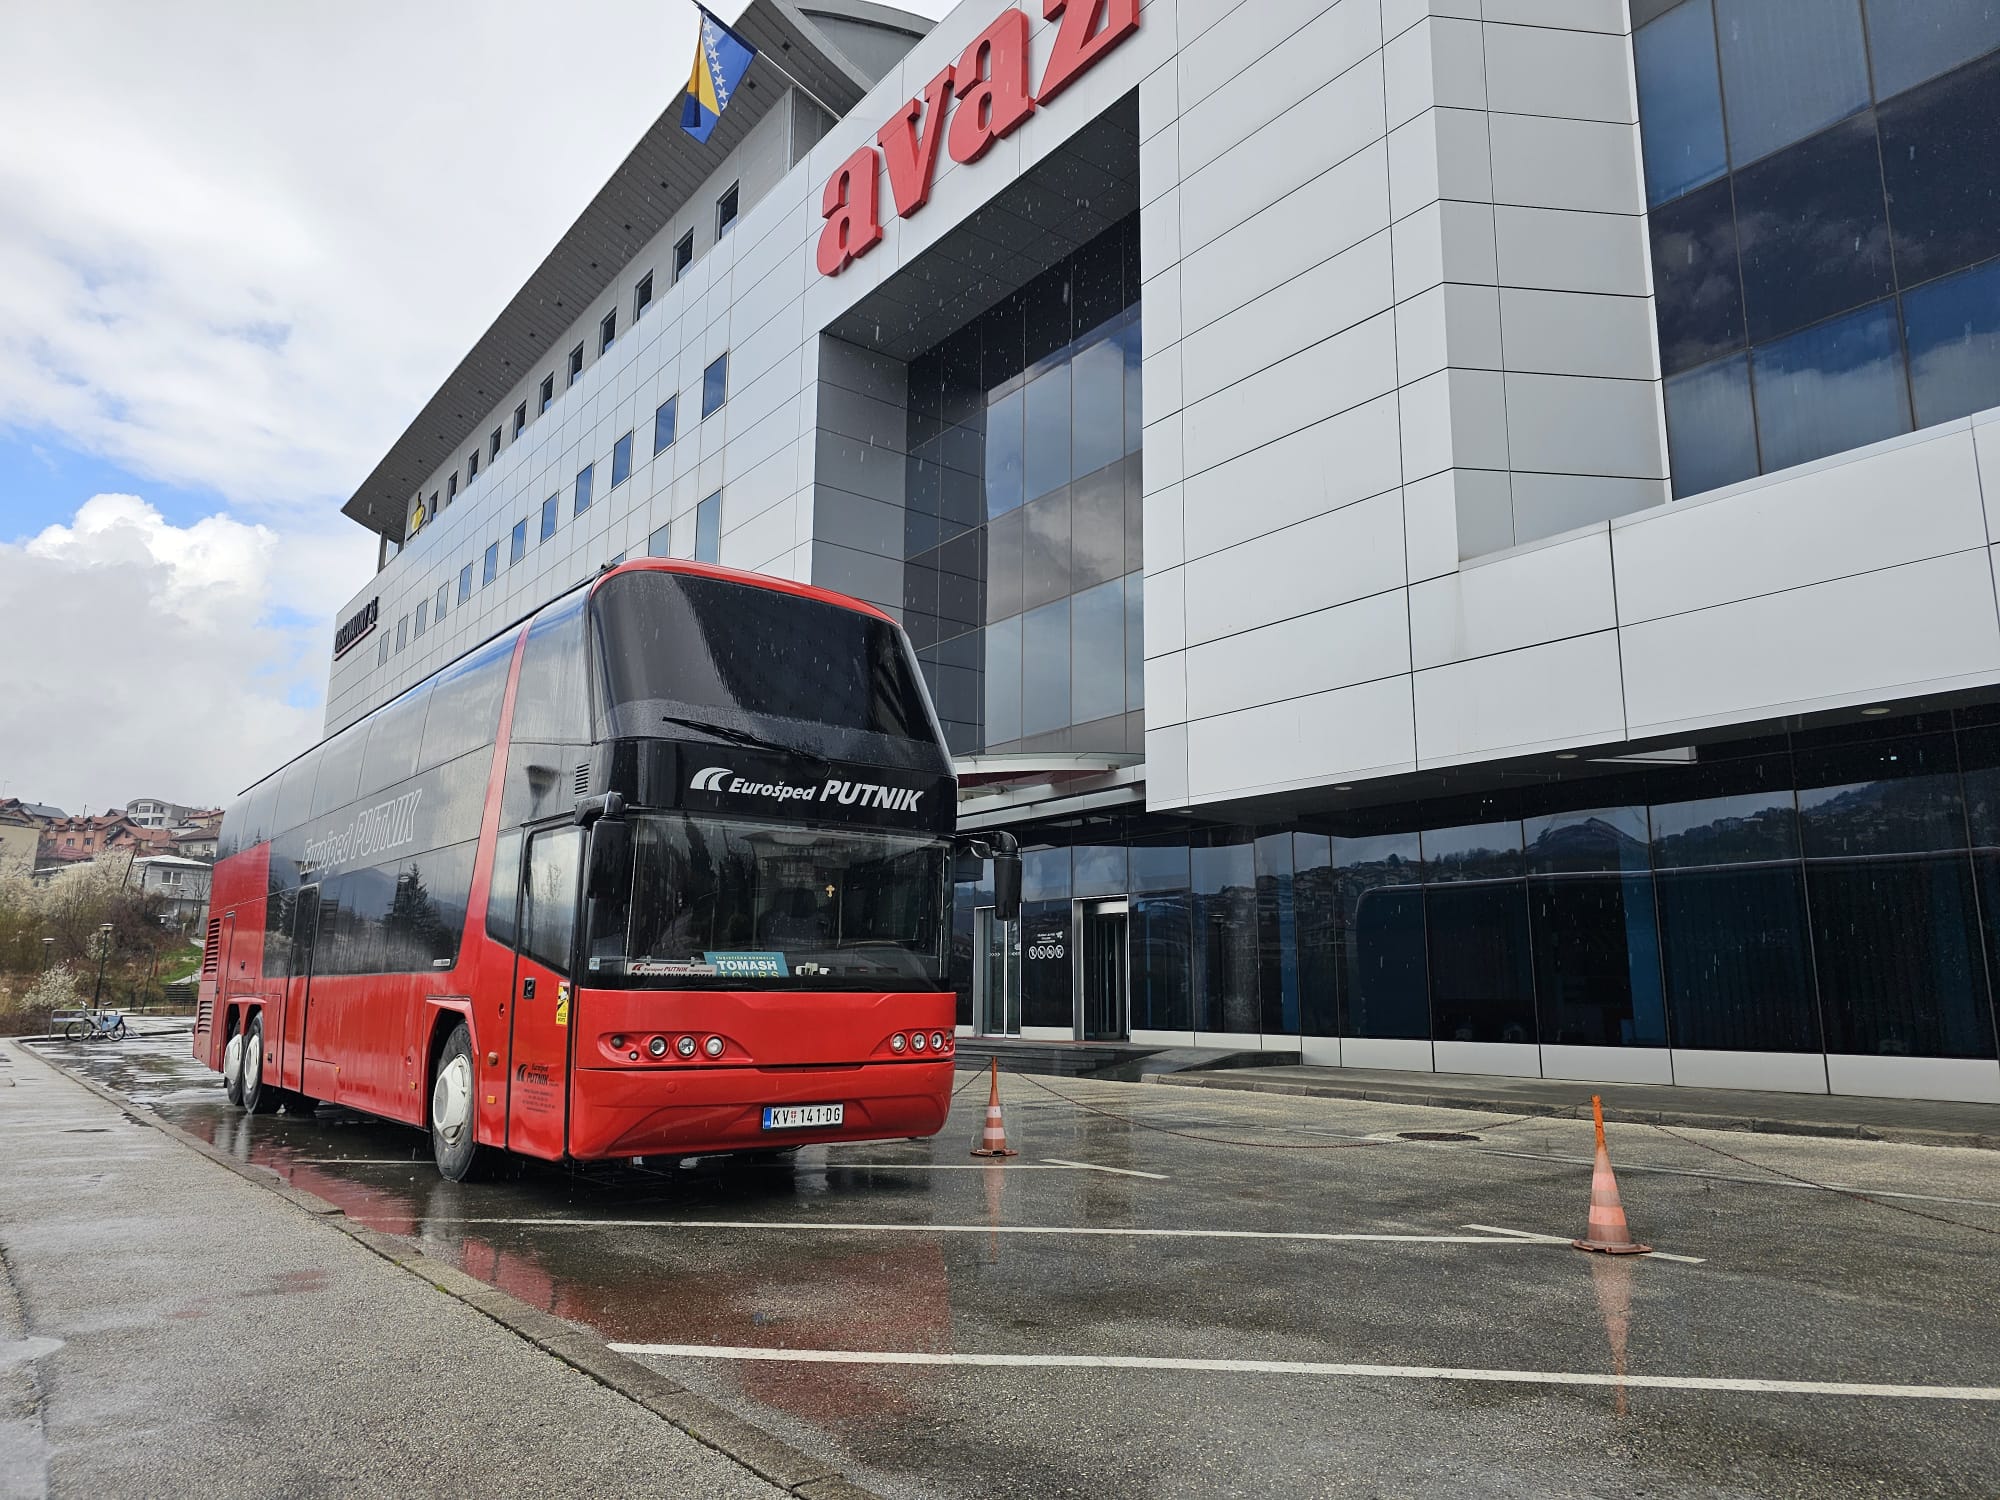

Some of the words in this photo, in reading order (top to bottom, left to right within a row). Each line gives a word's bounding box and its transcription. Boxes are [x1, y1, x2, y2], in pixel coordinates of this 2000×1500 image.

[816, 0, 1139, 277] avaz
[729, 778, 816, 802] Eurošped
[819, 779, 924, 812] PUTNIK
[351, 788, 423, 859] PUTNIK
[717, 960, 778, 971] TOMASH
[773, 1109, 789, 1125] KV
